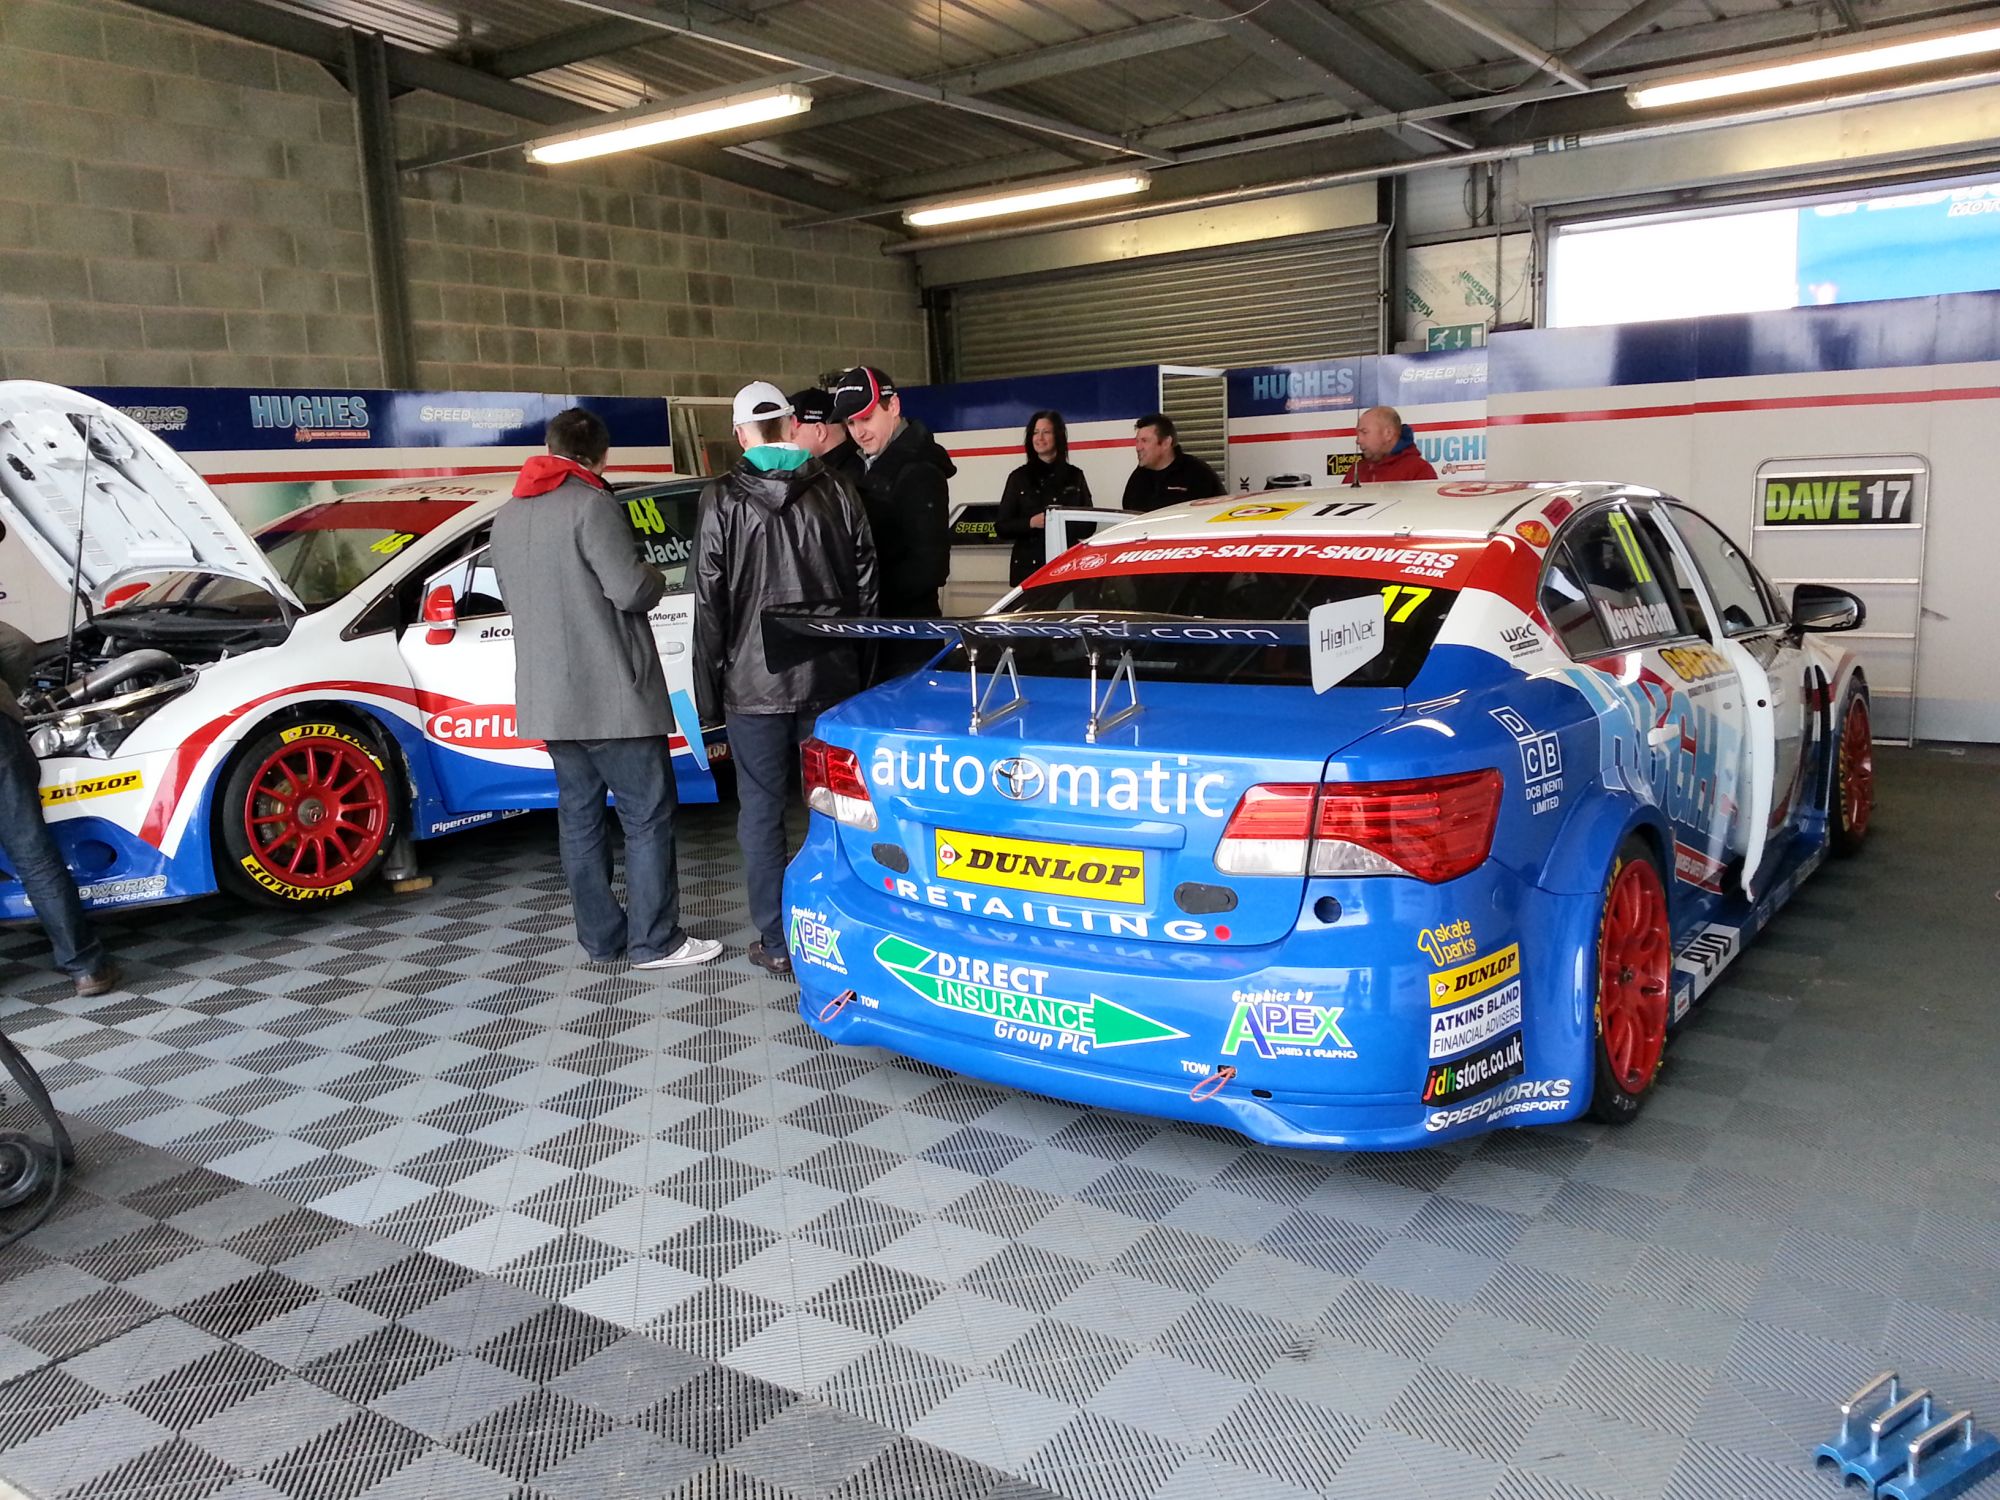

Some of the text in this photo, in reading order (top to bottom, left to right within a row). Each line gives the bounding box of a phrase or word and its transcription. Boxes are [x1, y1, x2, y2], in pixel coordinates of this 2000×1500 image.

[1253, 368, 1354, 401] HUGHES
[249, 395, 370, 428] HUGHES
[1417, 434, 1486, 463] UGH
[628, 497, 665, 535] 48
[1312, 502, 1377, 517] 17
[1765, 479, 1912, 521] DAVE 17
[370, 533, 415, 555] 48
[1110, 544, 1459, 569] HUGHES-SAFETY-SHOWERS
[1400, 565, 1448, 579] .CO.UK
[1380, 584, 1433, 624] 17
[1599, 596, 1678, 641] Newsham
[1319, 618, 1377, 653] HighNet
[1500, 623, 1537, 643] WRC
[49, 775, 138, 800] DUNLOP
[871, 743, 1225, 819] auto matic
[1526, 778, 1564, 801] DCB (KENT)
[431, 811, 493, 834] Pipercross
[1532, 796, 1559, 816] LIMITED
[966, 847, 1141, 887] DUNLOP
[93, 889, 166, 906] MOTORSPORT
[896, 877, 1208, 941] RETAILING
[789, 914, 846, 966] APEX
[1435, 918, 1472, 943] skate
[1442, 937, 1477, 964] parks
[937, 951, 1049, 995] DIRECT
[1453, 951, 1516, 993] DUNLOP
[860, 995, 879, 1010] TOW
[935, 978, 1096, 1033] INSURANCE
[1231, 988, 1314, 1006] Graphics by
[1434, 985, 1520, 1034] ATKINS BLAND
[994, 1020, 1092, 1056] Group Plc
[1220, 1000, 1354, 1060] APEX
[1433, 1004, 1520, 1054] FINANCIAL ADVISERS
[1181, 1059, 1211, 1076] TOW
[1423, 1035, 1523, 1101] jdhstore.co.uk
[1425, 1078, 1572, 1133] SPEEDWORKS
[1486, 1100, 1570, 1124] MOTORSPORT
